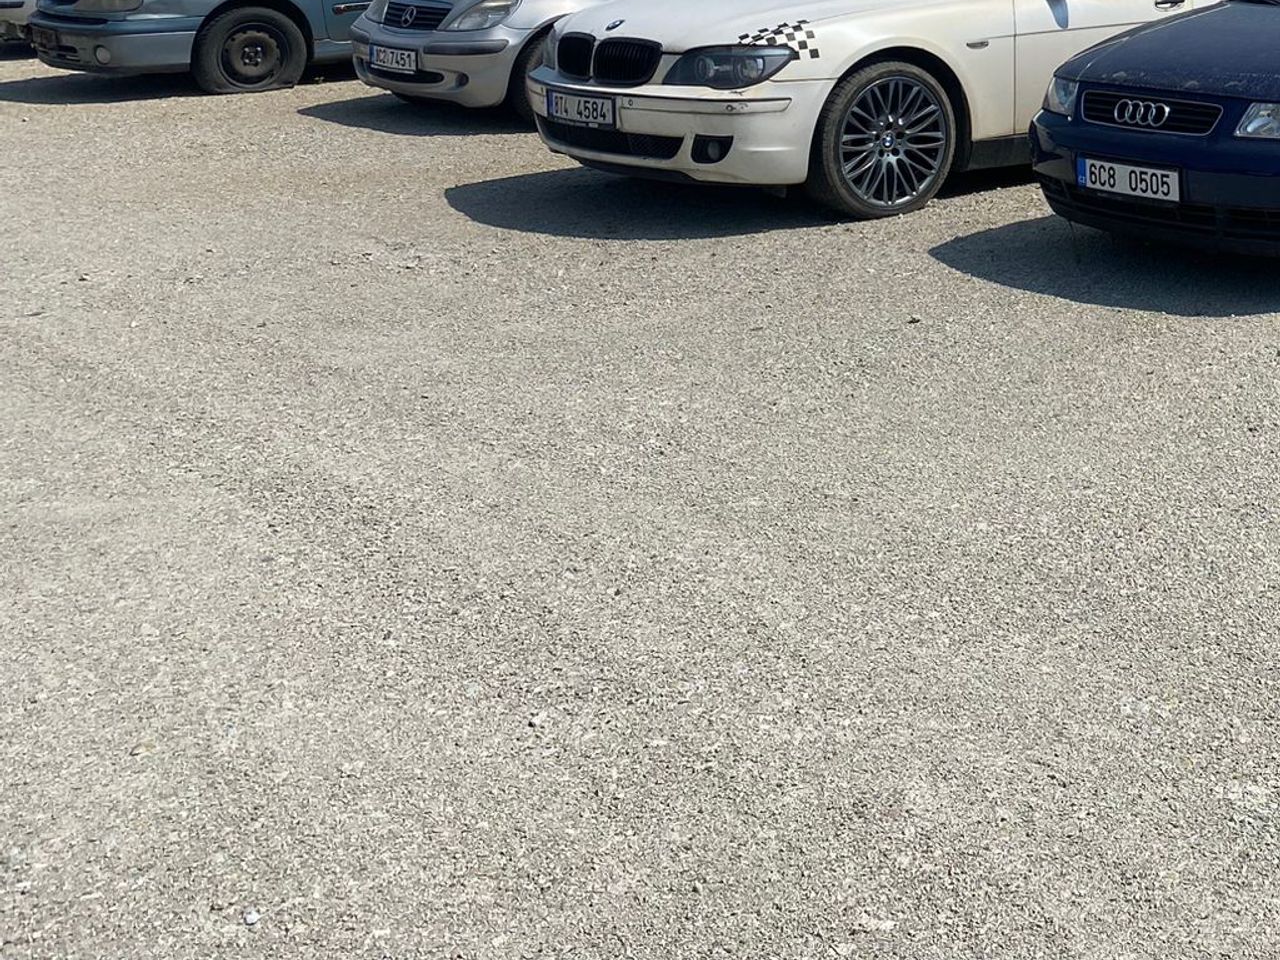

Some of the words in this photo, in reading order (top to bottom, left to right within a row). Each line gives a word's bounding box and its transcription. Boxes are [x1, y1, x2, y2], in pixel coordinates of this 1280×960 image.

[389, 50, 412, 67] 7451
[576, 99, 607, 121] 4584
[1089, 163, 1116, 188] 6C8
[1129, 170, 1170, 196] 0505
